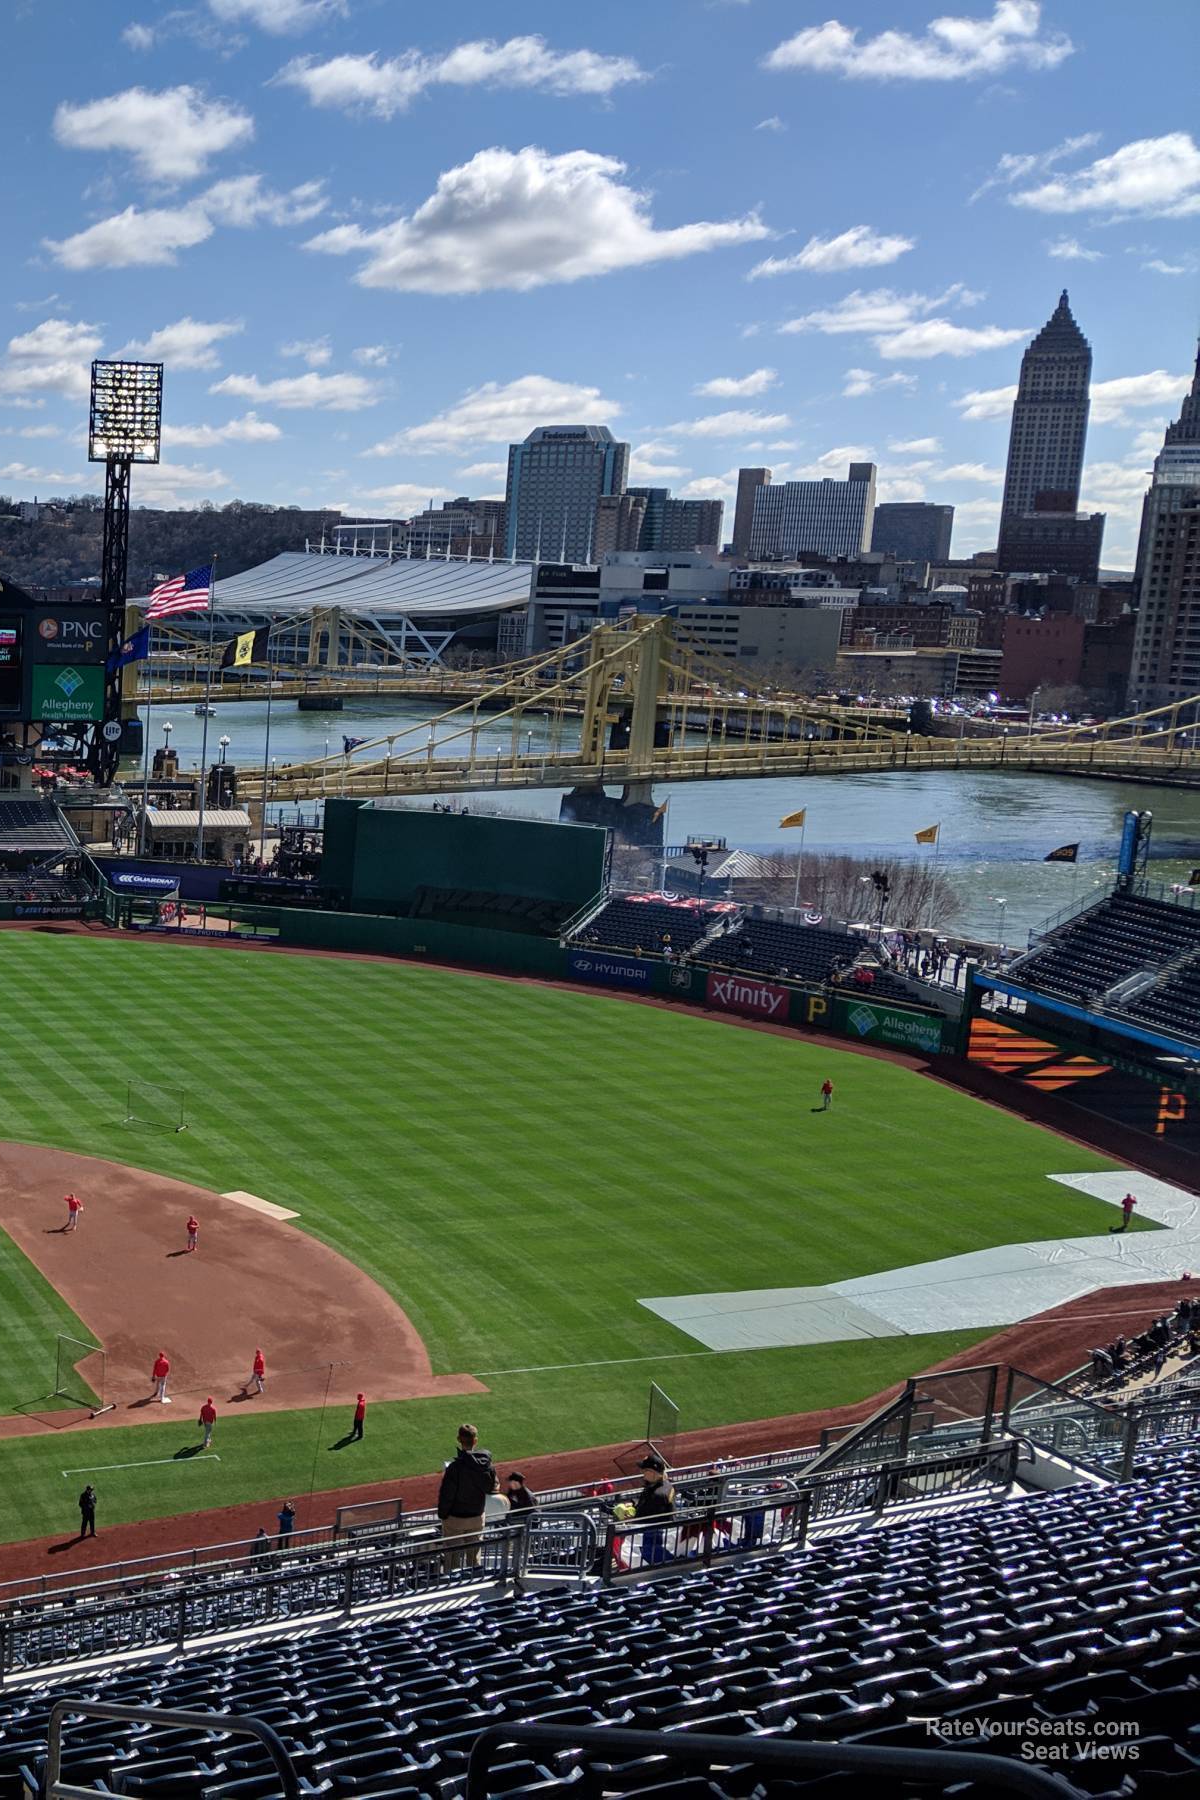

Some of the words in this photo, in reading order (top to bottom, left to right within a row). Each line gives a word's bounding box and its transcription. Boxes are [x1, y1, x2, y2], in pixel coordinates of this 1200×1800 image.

[61, 621, 103, 638] PNC
[42, 699, 94, 712] Allegheny
[41, 712, 62, 720] Health
[64, 712, 93, 720] Network
[105, 725, 120, 736] Lite
[133, 876, 176, 886] GUARDIAN
[595, 963, 647, 980] HYUNDAI
[713, 979, 784, 1014] xfinity
[807, 996, 827, 1023] P
[881, 1029, 906, 1041] Health
[882, 1016, 941, 1039] Allegheny
[1155, 1085, 1188, 1140] P
